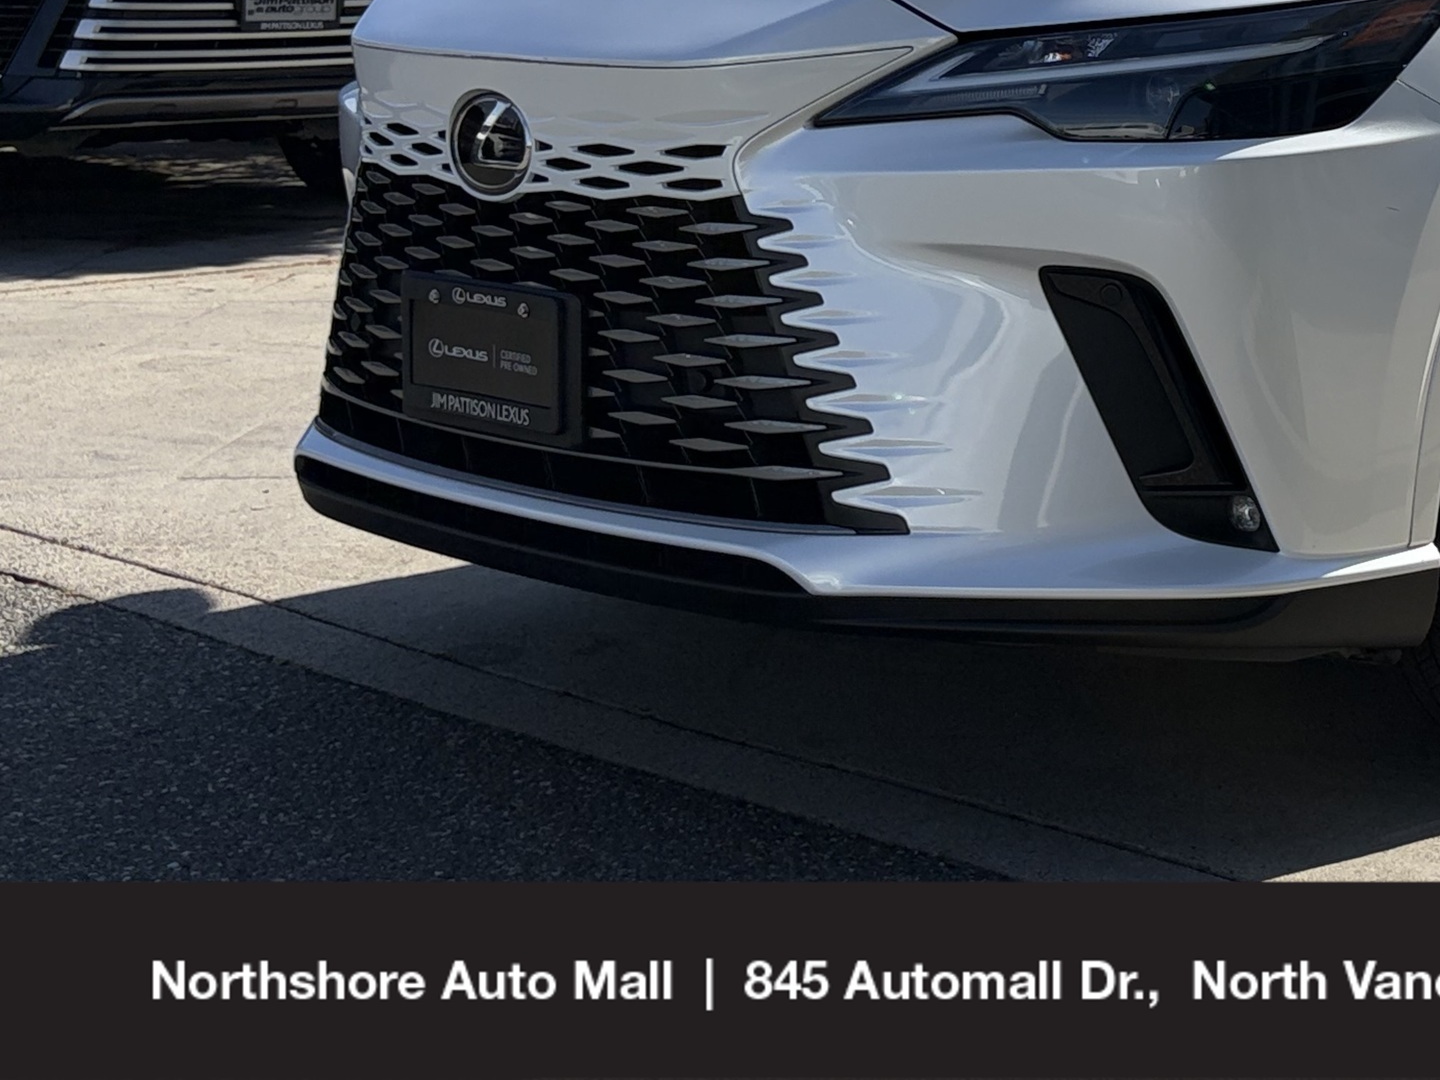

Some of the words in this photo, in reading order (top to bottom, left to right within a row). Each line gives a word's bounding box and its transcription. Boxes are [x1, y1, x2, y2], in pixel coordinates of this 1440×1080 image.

[265, 5, 295, 14] auto
[466, 291, 507, 308] LEXUS
[445, 344, 489, 362] LEXUS
[500, 349, 532, 364] CERTIFIED
[500, 360, 512, 371] PRE
[512, 362, 538, 376] OWNED
[430, 392, 447, 410] JIM
[448, 394, 496, 419] PATTISON
[496, 404, 530, 426] LEXUS
